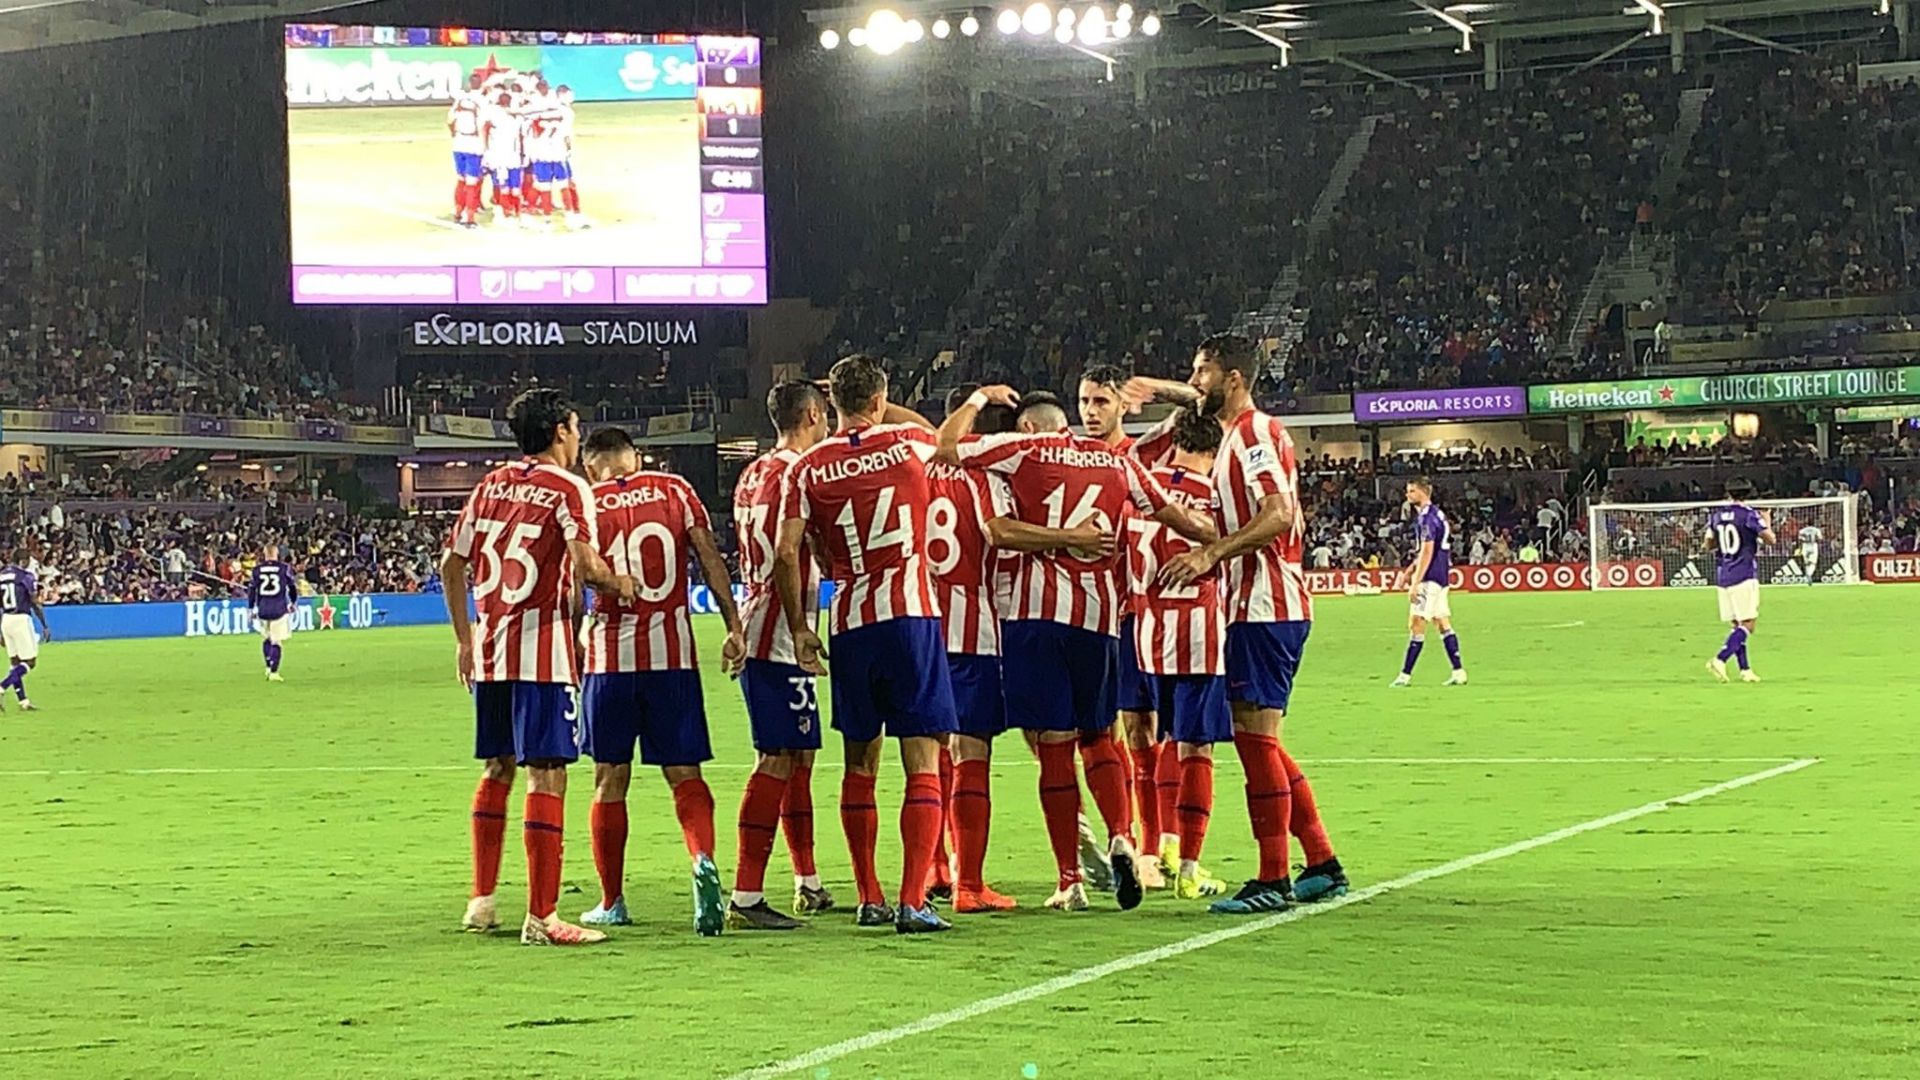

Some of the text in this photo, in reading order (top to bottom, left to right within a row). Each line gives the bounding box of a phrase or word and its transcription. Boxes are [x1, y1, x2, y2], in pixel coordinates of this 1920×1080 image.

[583, 320, 698, 345] STADIUM
[1549, 384, 1653, 408] Heineken
[1700, 370, 1907, 402] CHURCH STREET LOUNGE
[1444, 395, 1512, 410] RESORTS
[811, 443, 912, 485] M.LLORENTE
[595, 486, 668, 513] CORREA
[834, 485, 915, 575] 14
[1042, 482, 1113, 563] 16
[1716, 523, 1740, 555] 10
[473, 518, 539, 605] 35
[605, 521, 677, 602] 10
[259, 573, 280, 596] 23
[1670, 577, 1708, 586] adidas
